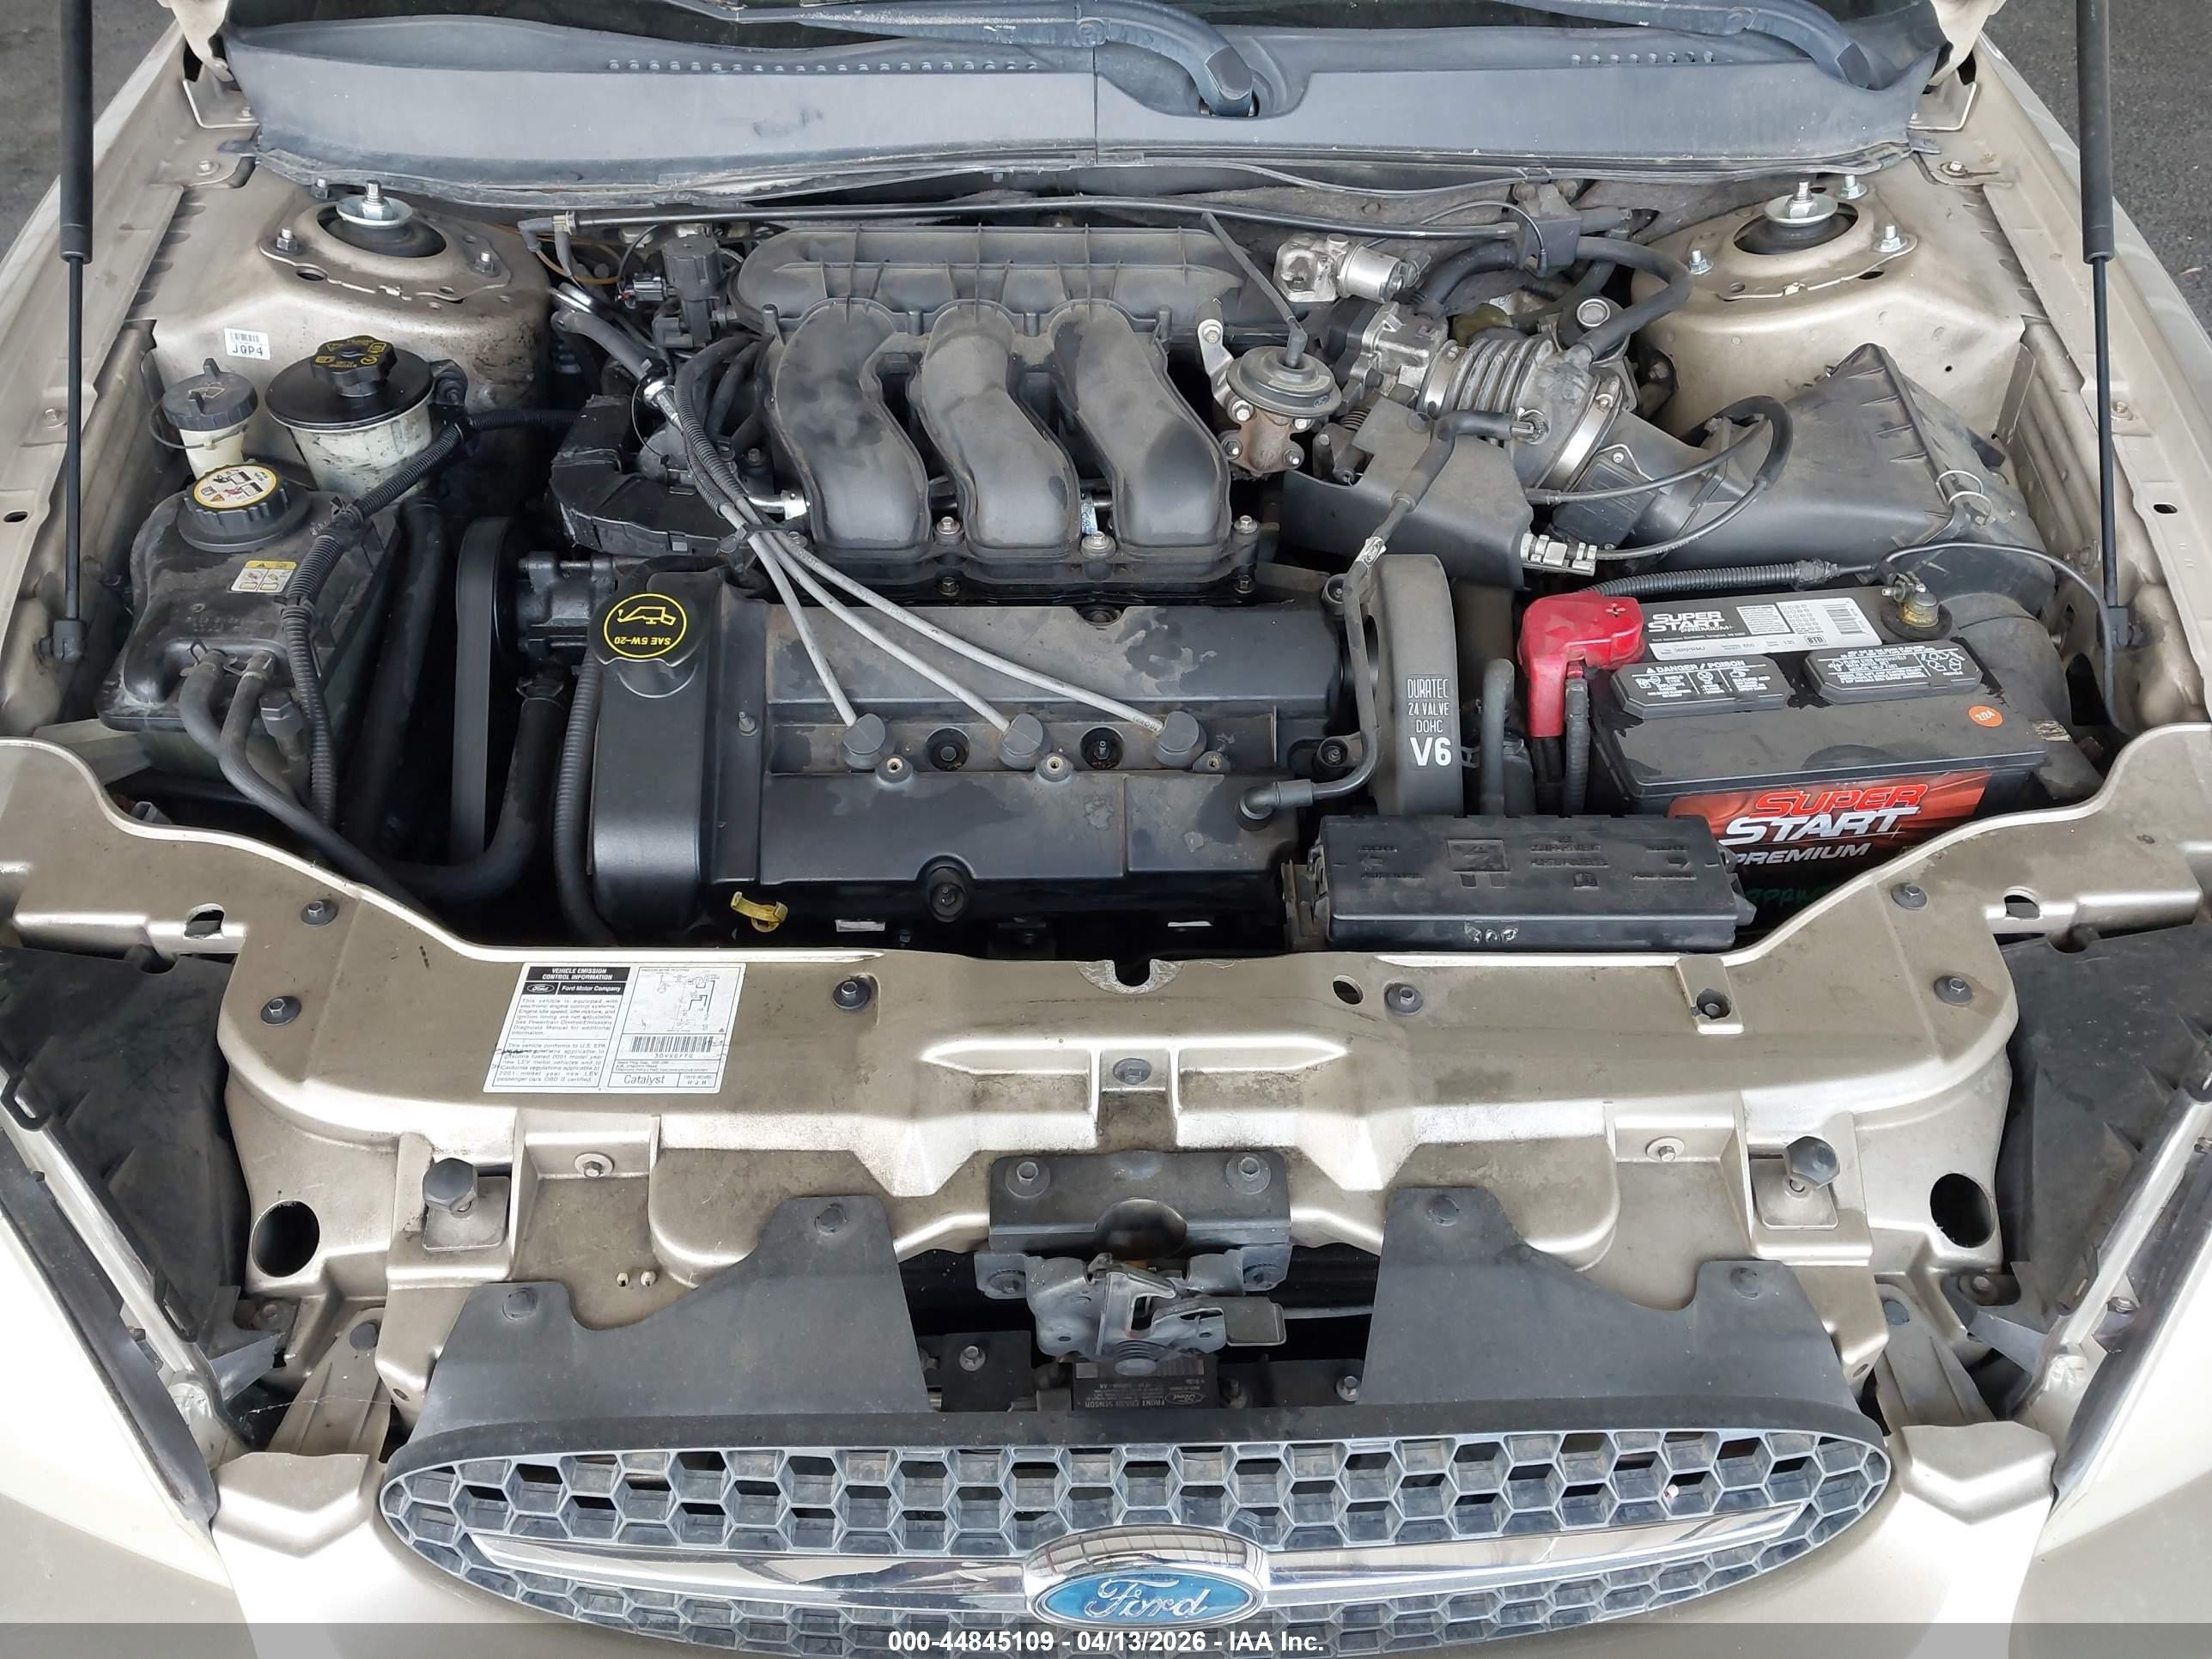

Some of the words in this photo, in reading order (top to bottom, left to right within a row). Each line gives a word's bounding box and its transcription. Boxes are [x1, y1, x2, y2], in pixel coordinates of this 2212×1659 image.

[232, 343, 263, 356] JQP4
[1652, 611, 1722, 623] SUPER
[1648, 618, 1725, 632] START
[614, 636, 648, 645] 5W-20
[651, 637, 672, 646] SAE
[1656, 664, 1698, 673] DANGER
[1708, 659, 1746, 668] POISON
[1407, 678, 1449, 699] DURATEC
[1408, 702, 1419, 716] 24
[1422, 702, 1450, 716] VALVE
[1416, 720, 1443, 733] DOHC
[1409, 736, 1452, 766] V6
[1750, 783, 1929, 817] SUPER
[1717, 806, 1920, 846] START
[623, 1074, 665, 1085] Catalyst
[1084, 1577, 1209, 1620] Ford
